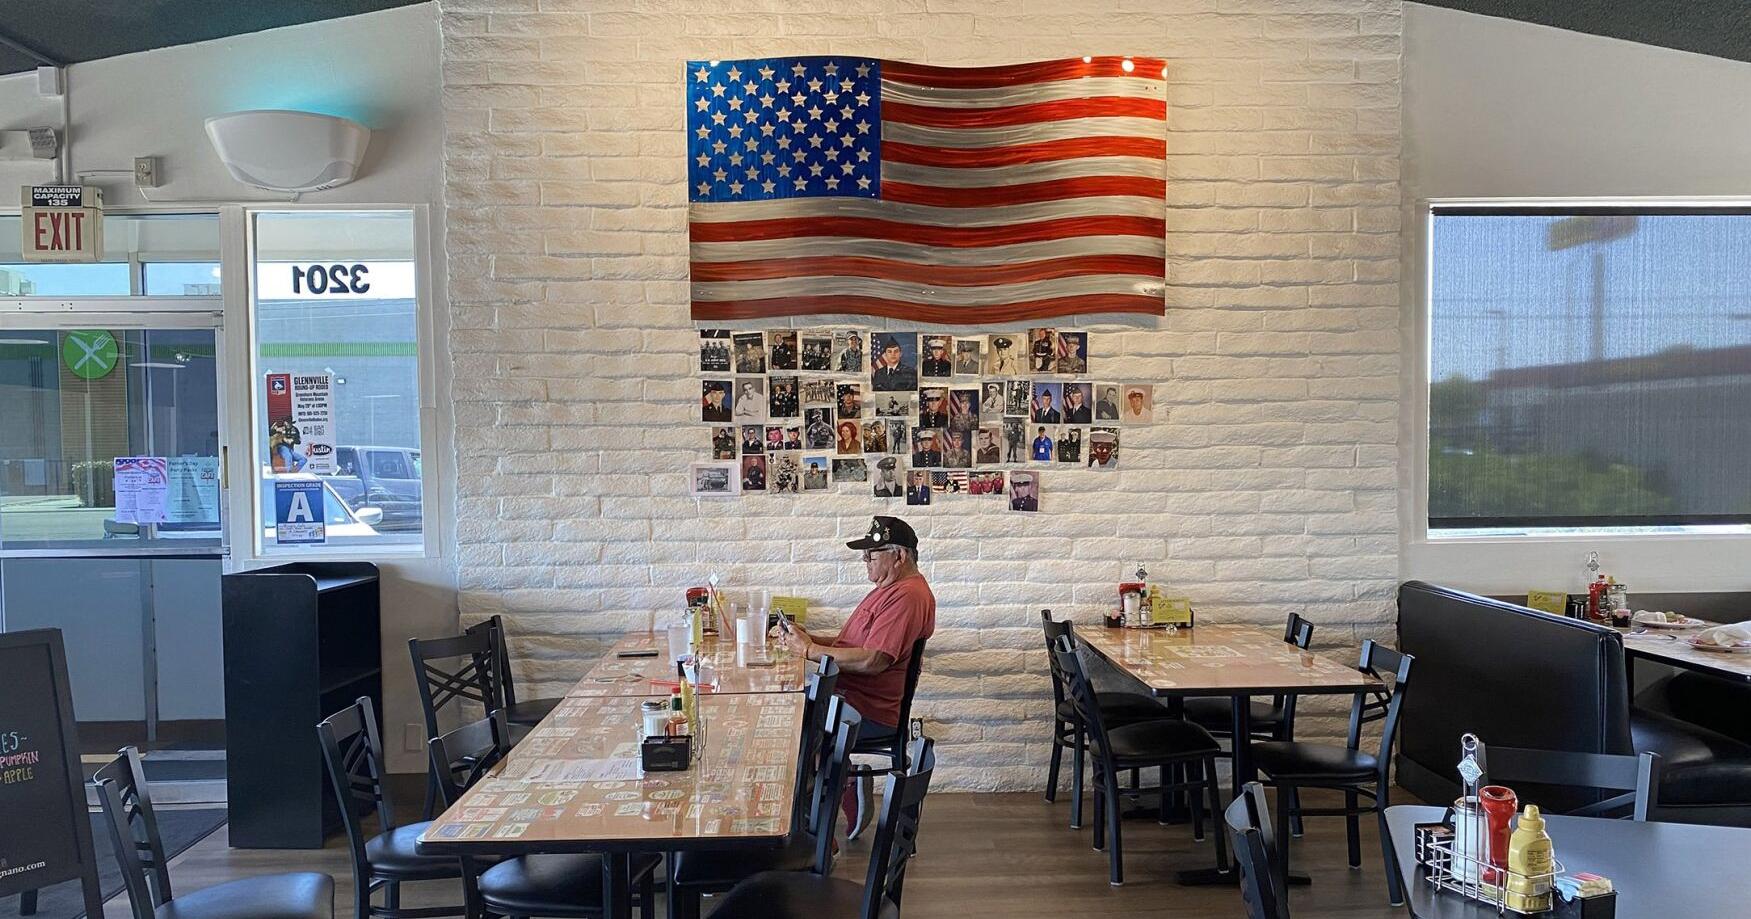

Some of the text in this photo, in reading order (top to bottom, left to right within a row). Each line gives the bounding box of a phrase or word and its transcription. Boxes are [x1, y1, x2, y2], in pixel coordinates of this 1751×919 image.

[34, 212, 85, 251] EXIT
[294, 376, 328, 384] GLENNVILLE
[306, 443, 332, 457] Justin
[287, 491, 315, 522] A
[0, 750, 40, 769] PUMPKIN
[3, 767, 34, 784] APPLE
[0, 861, 46, 879] nano.com
